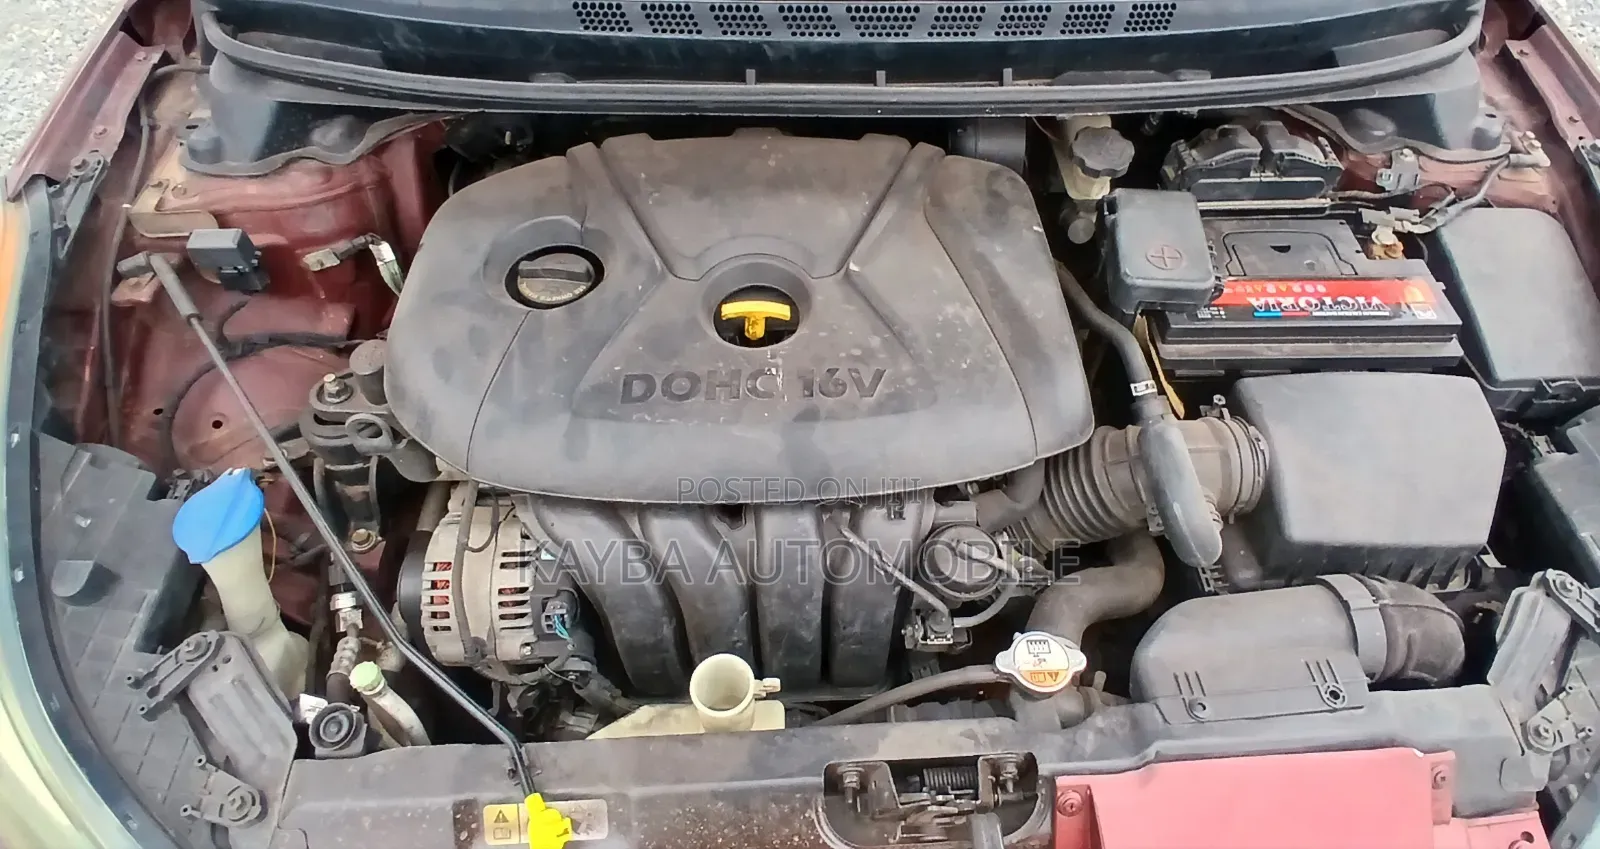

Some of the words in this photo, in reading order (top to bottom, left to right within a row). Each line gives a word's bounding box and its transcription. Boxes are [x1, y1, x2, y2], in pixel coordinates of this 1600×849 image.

[1246, 295, 1391, 312] VICTORIA
[620, 369, 780, 404] DOHC
[798, 367, 886, 399] 16V
